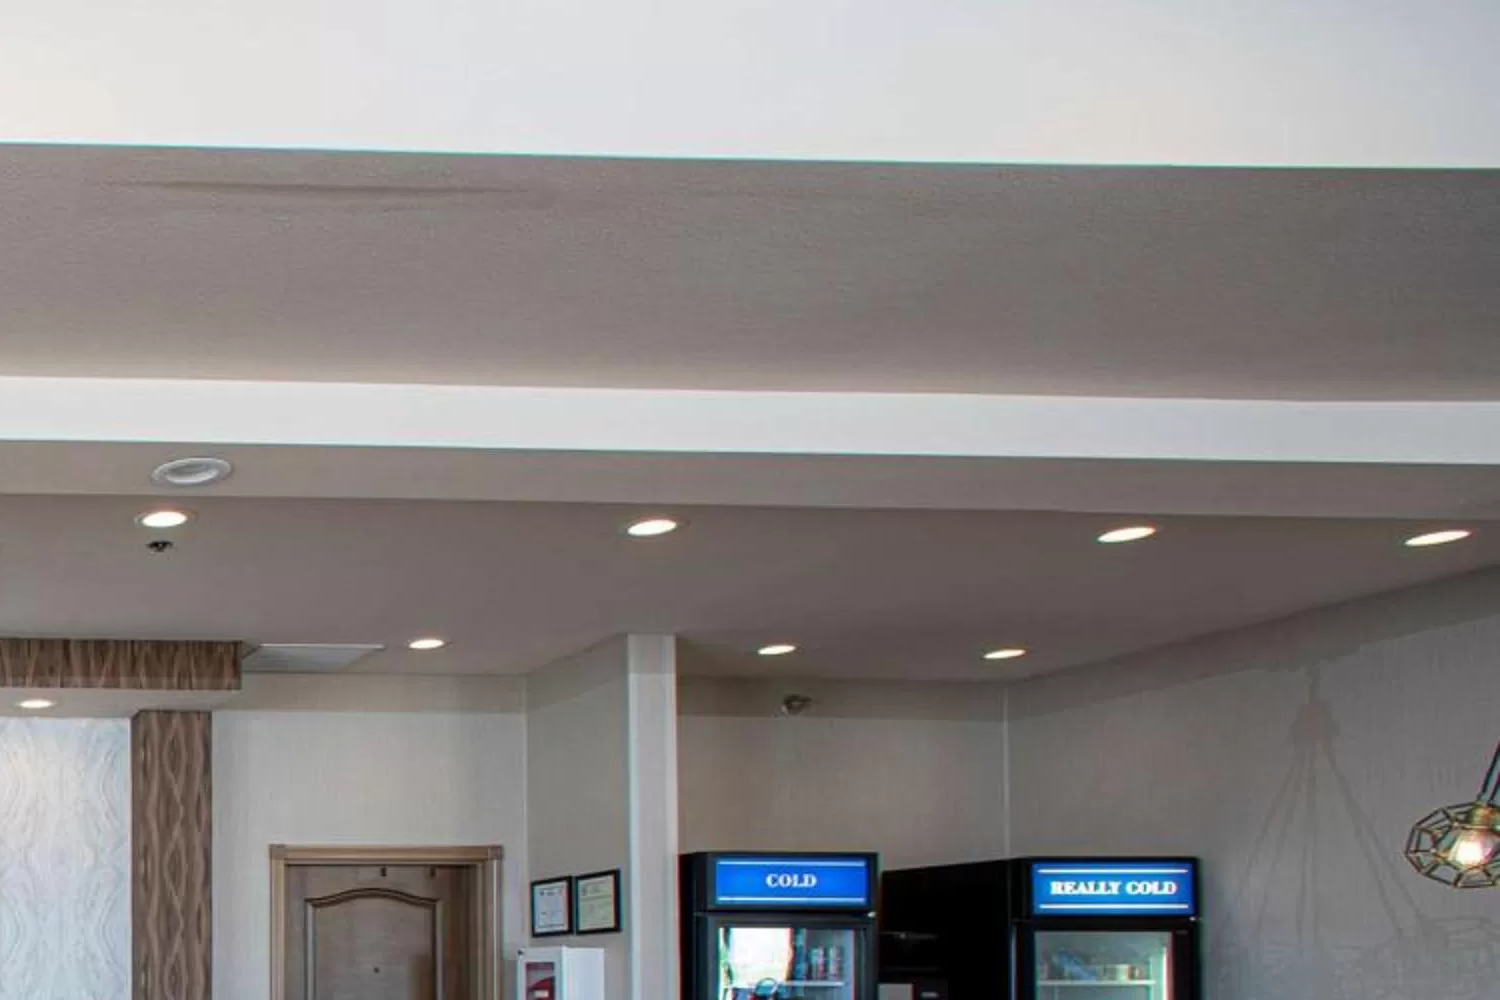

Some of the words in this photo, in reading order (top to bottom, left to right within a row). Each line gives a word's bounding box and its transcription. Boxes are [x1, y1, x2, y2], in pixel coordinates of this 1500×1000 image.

[765, 873, 817, 888] COLD
[1050, 881, 1122, 895] REALLY
[1125, 881, 1177, 895] COLD
